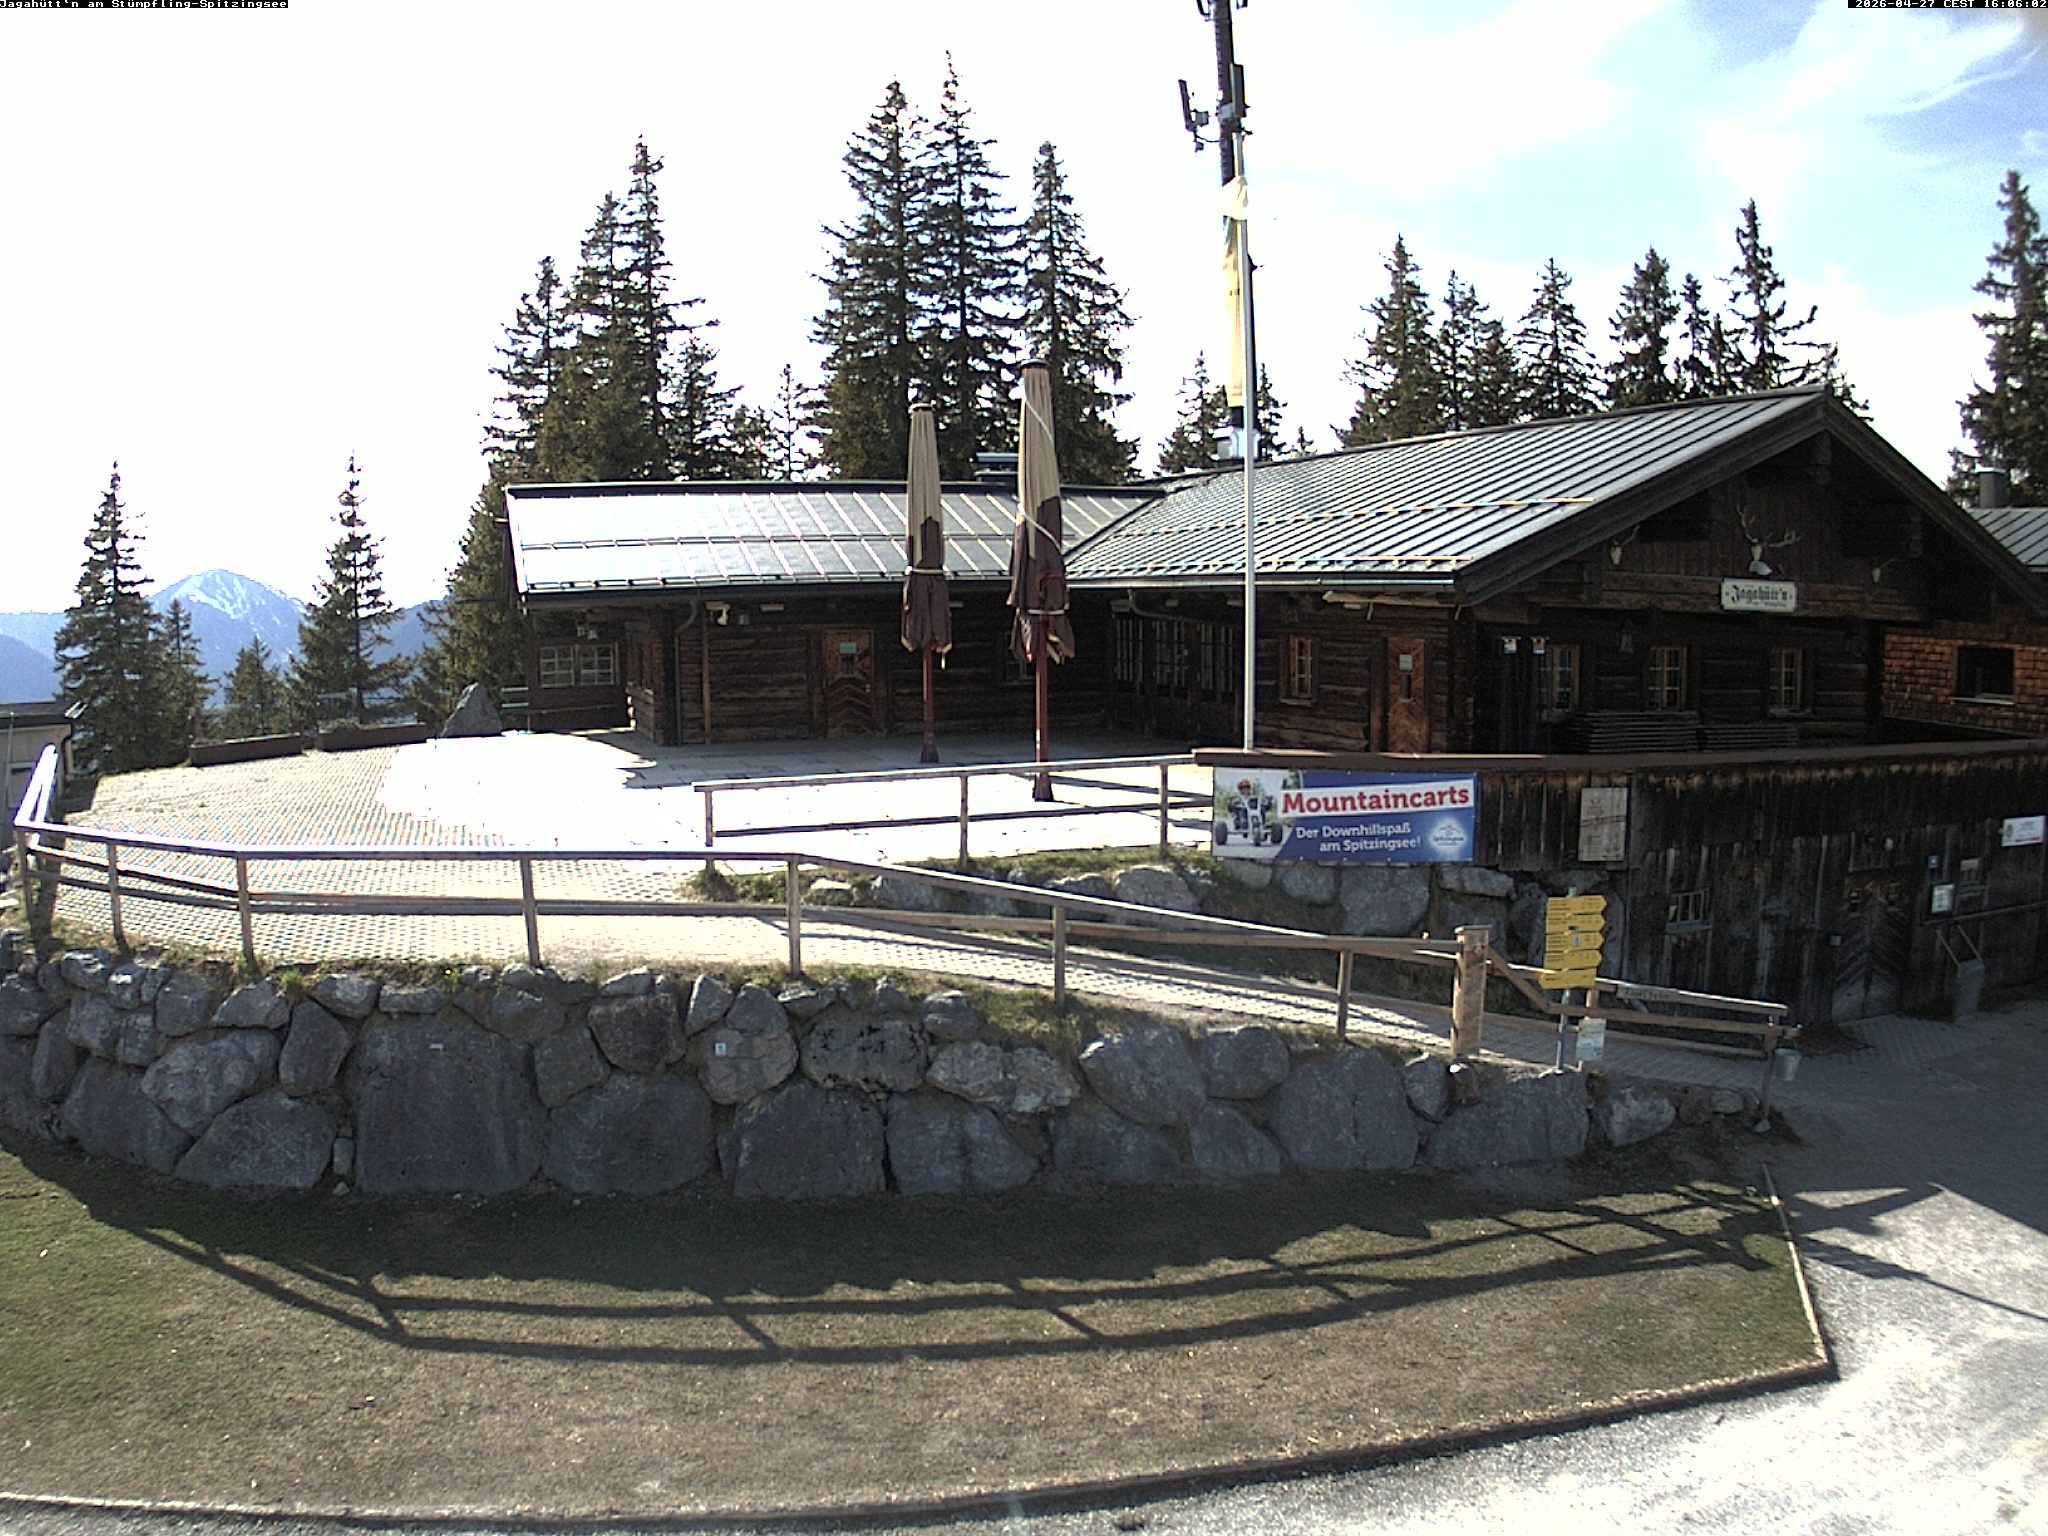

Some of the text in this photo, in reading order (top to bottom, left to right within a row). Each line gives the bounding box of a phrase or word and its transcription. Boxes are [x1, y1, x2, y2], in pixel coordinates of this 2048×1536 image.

[1282, 786, 1470, 814] Mountaincarts
[1296, 822, 1412, 839] Der Downhillspaß
[1319, 842, 1341, 853] am
[1343, 837, 1421, 854] Spitzingsee!
